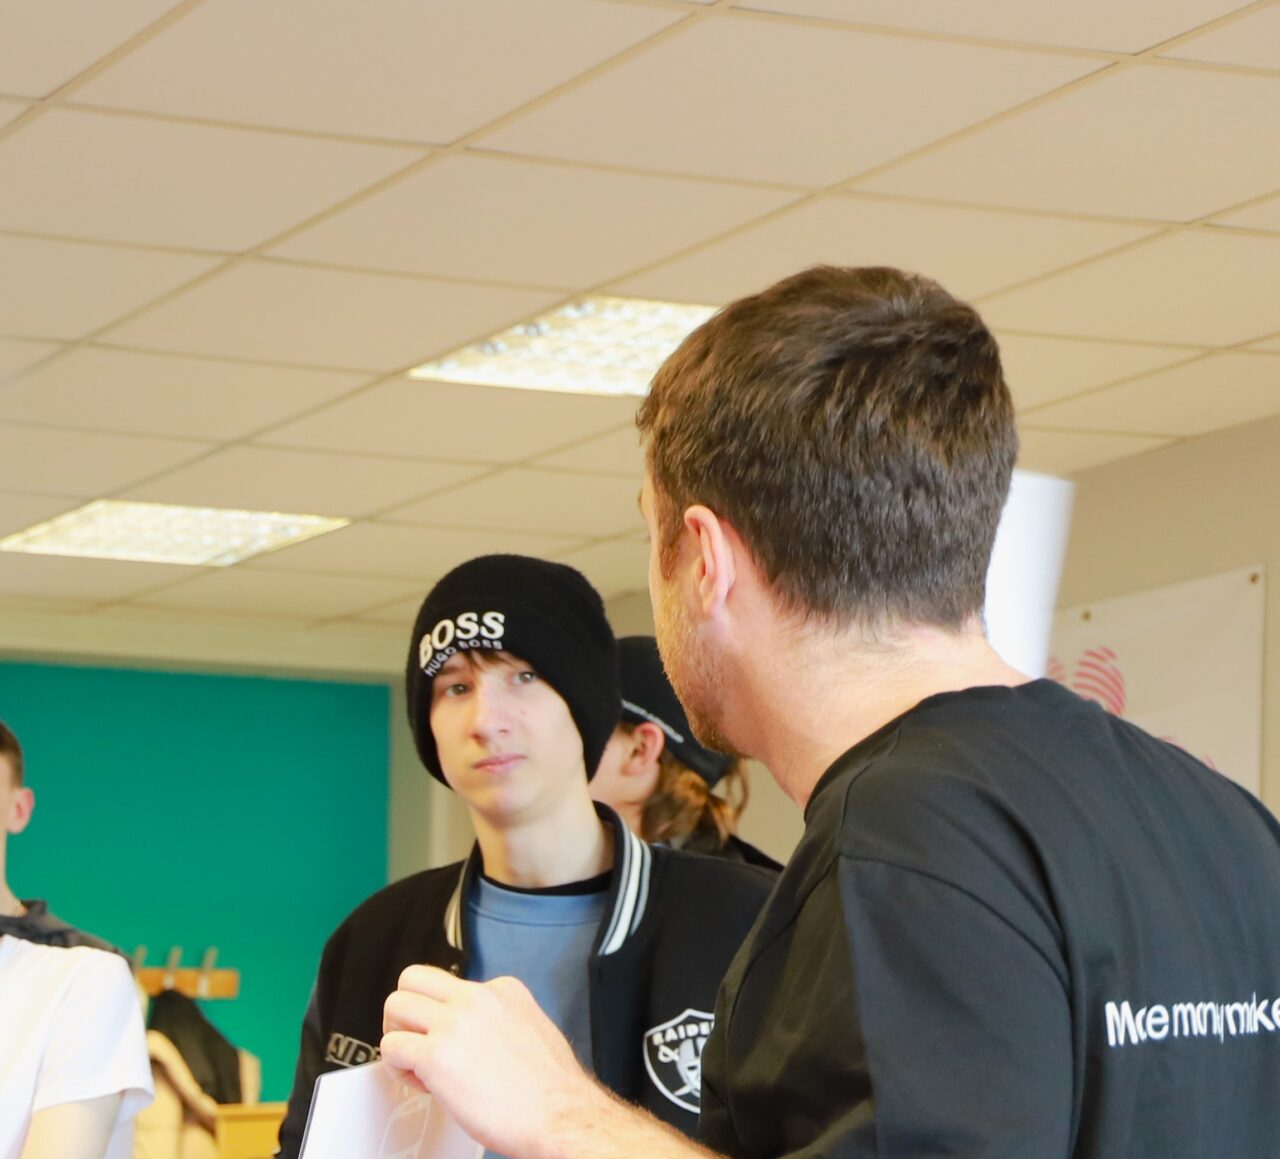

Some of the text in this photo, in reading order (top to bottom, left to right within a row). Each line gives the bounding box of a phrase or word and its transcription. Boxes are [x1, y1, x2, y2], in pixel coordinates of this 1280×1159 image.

[418, 610, 506, 670] BOSS
[423, 638, 503, 678] HUGO BOSS
